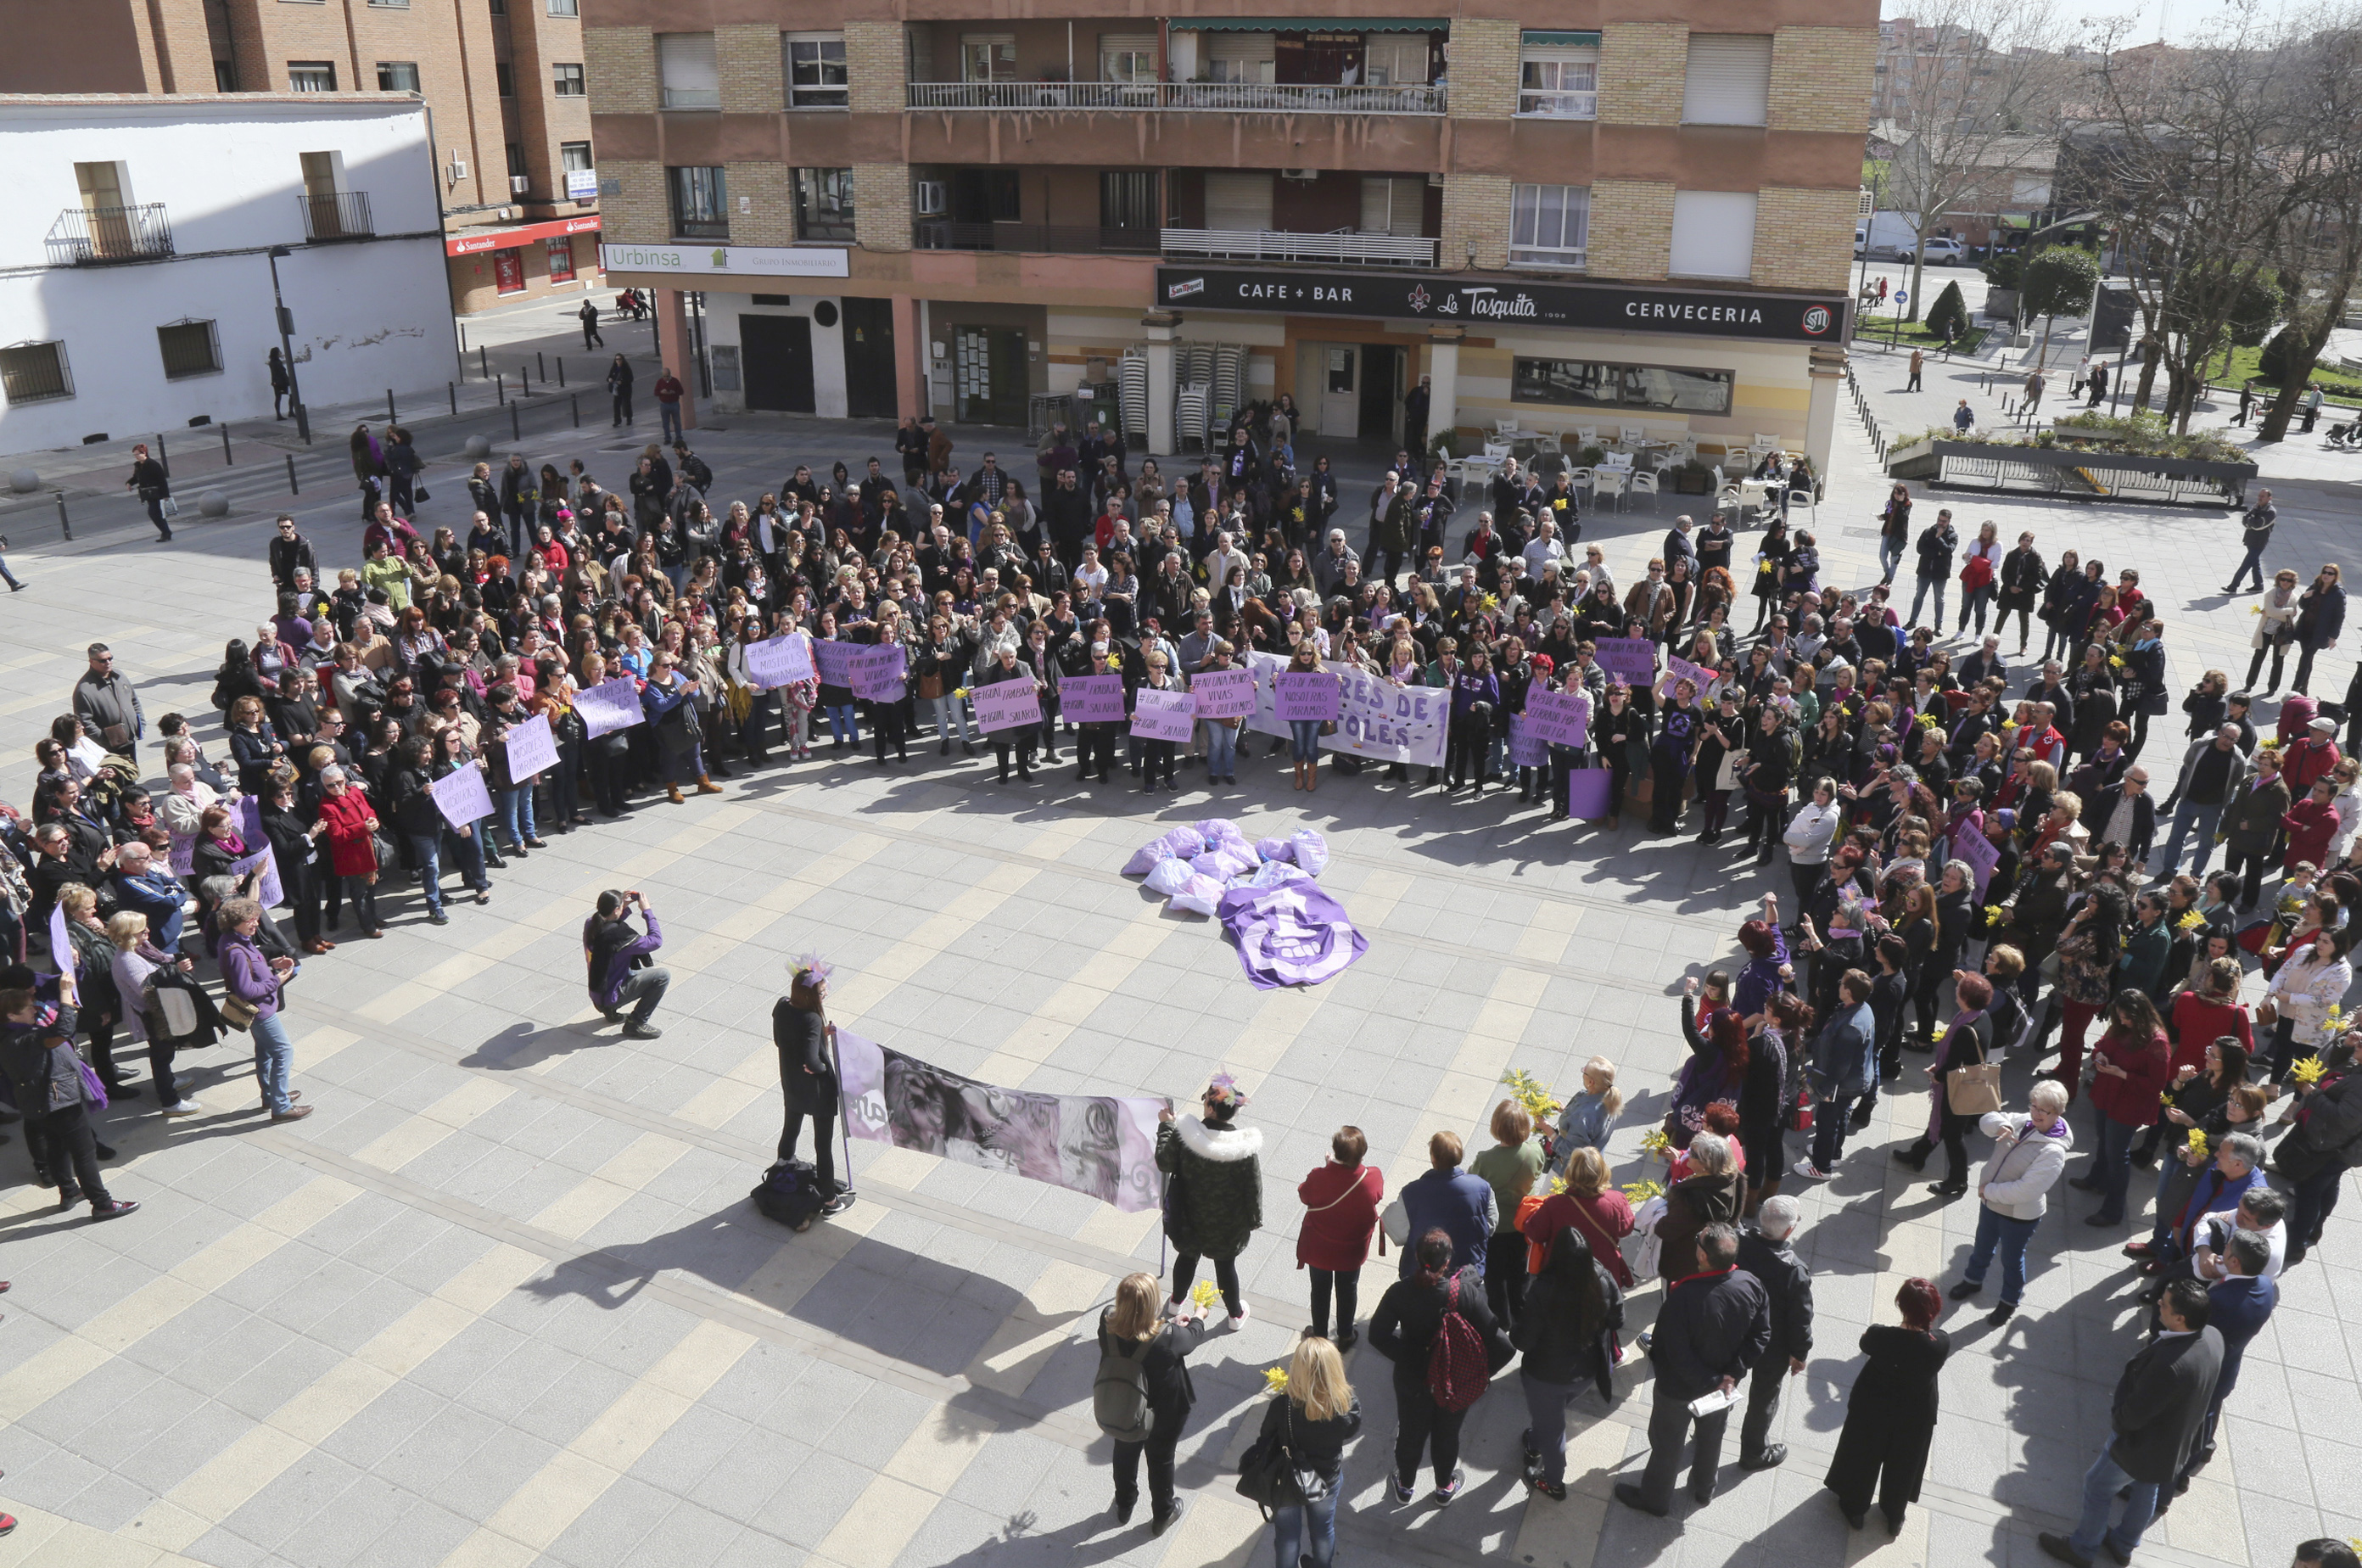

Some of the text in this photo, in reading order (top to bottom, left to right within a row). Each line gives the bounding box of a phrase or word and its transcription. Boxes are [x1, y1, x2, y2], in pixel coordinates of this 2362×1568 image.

[574, 221, 598, 230] Santander
[466, 238, 495, 251] Santander
[613, 248, 680, 266] Urbinsa
[1170, 287, 1183, 297] San
[1239, 283, 1352, 302] CAFE BAR
[1437, 293, 1459, 314] La
[1461, 287, 1537, 320] Tasquita
[1626, 301, 1762, 323] CERVECERIA
[1610, 655, 1636, 667] VIVAS
[761, 665, 805, 686] PARAMOS
[864, 668, 888, 681] VIVAS
[1194, 672, 1251, 689] #NI UNA MENOS
[854, 684, 867, 695] NOS
[1002, 685, 1033, 701] TRABAJO
[1207, 688, 1234, 702] VIVAS
[1285, 692, 1328, 703] NOSOTRAS
[1088, 702, 1120, 713] SALARIO
[1197, 700, 1254, 715] NOS QUEREMOS
[1286, 705, 1328, 716] PARAMOS
[1396, 693, 1429, 720] DE
[1545, 696, 1554, 707] DE
[1556, 698, 1583, 713] MARZO
[1009, 708, 1038, 723] SALARIO
[1529, 706, 1579, 727] CERRADO POR
[516, 750, 550, 777] PARAMOS
[456, 766, 477, 788] MARZO
[444, 784, 478, 812] NOSOTRAS
